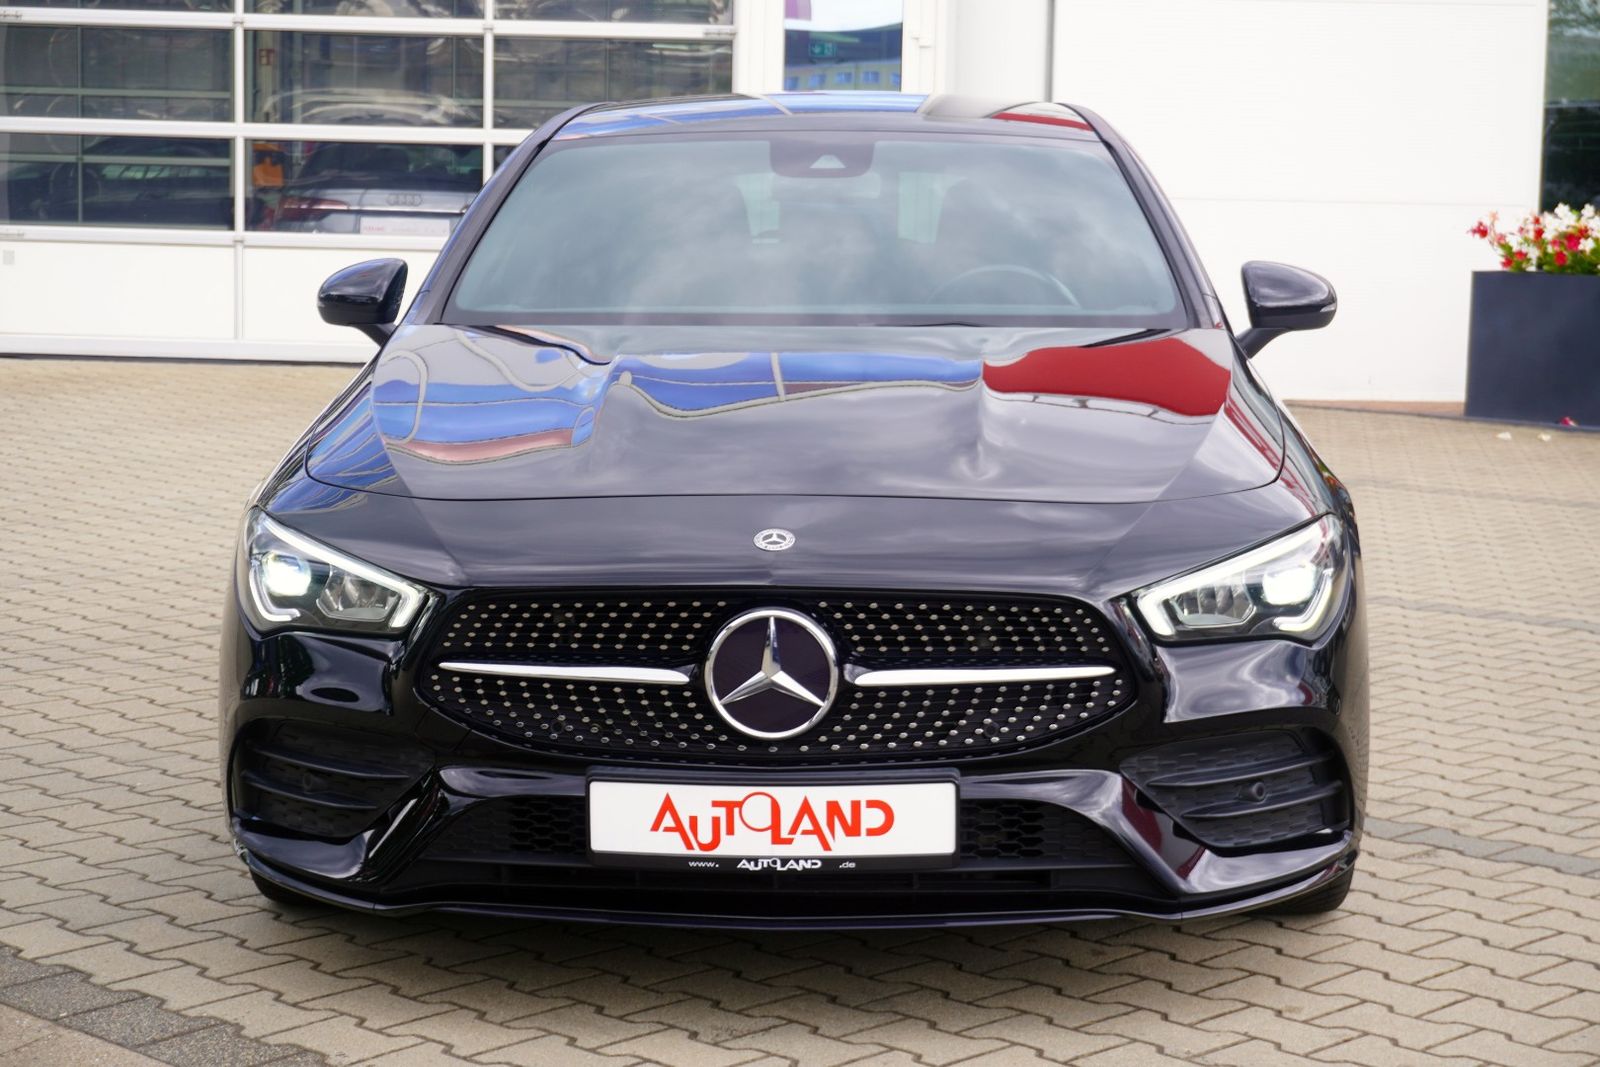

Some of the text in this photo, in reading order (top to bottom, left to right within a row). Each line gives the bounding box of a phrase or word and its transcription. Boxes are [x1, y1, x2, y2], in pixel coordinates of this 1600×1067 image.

[650, 791, 895, 853] AUTOLAND
[688, 857, 857, 871] www. AUTOLAND .de
